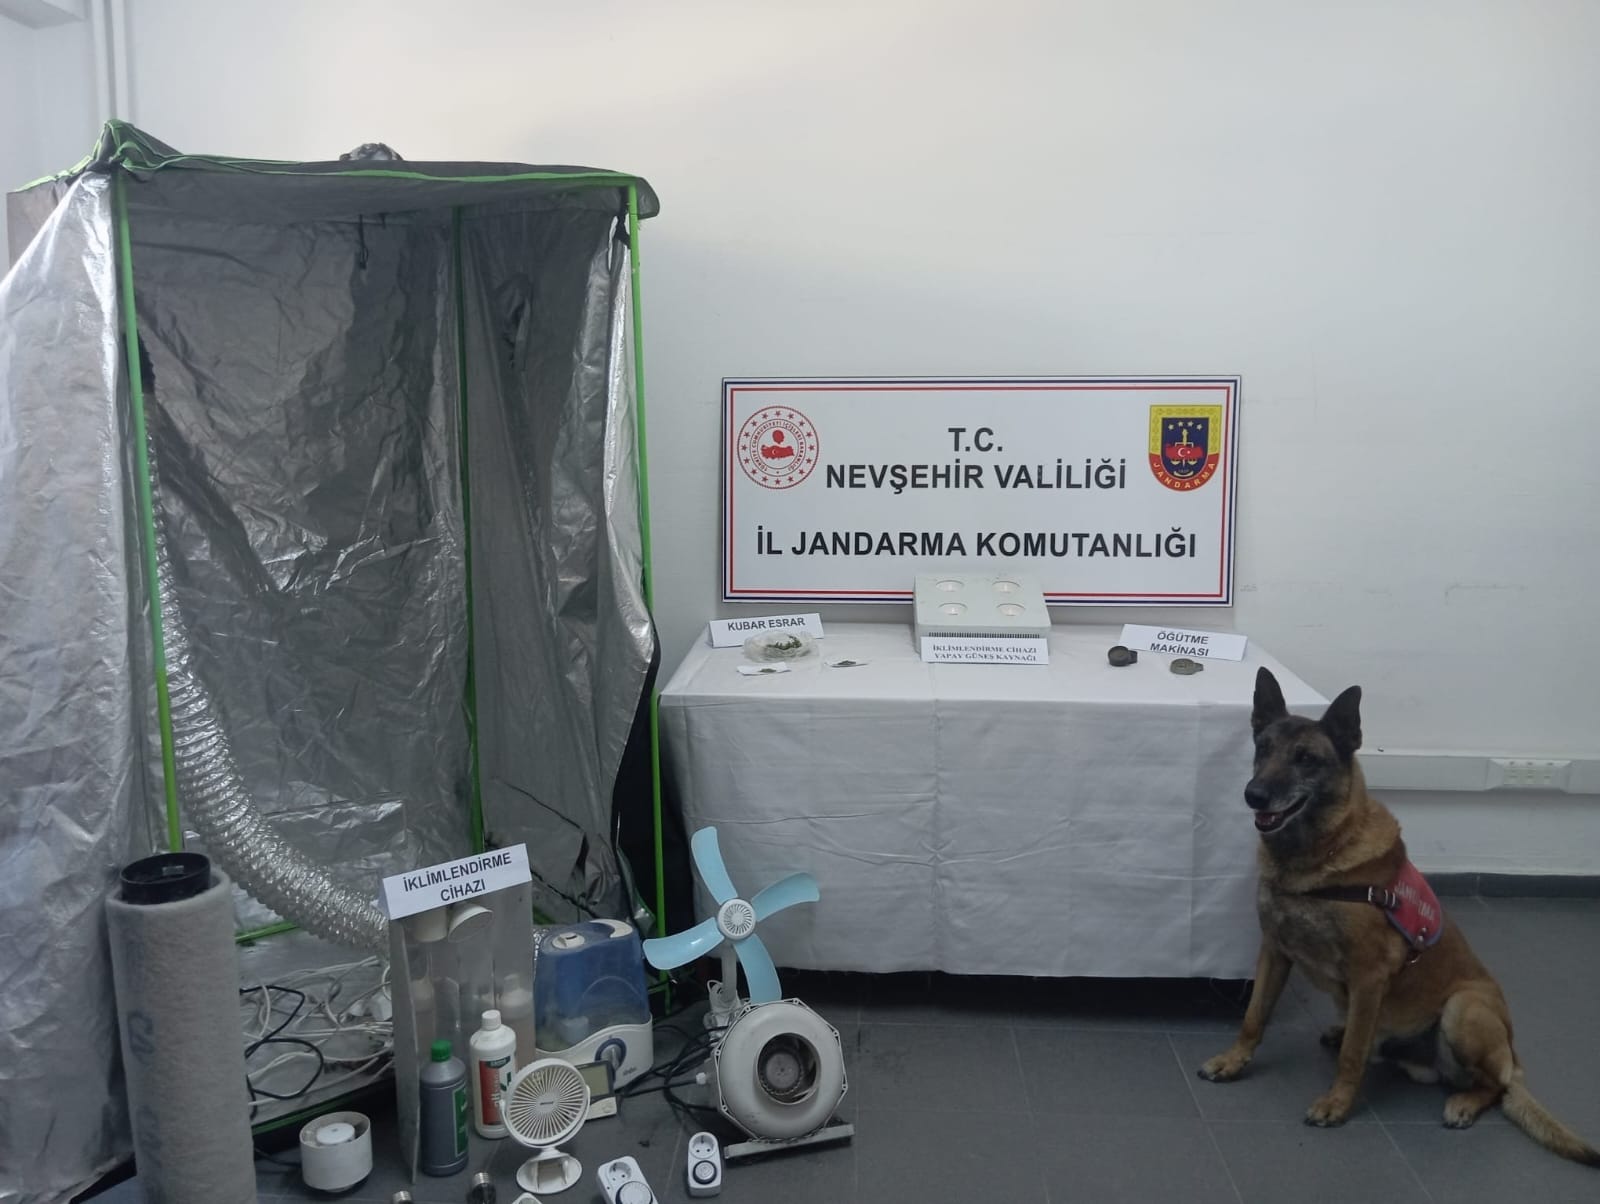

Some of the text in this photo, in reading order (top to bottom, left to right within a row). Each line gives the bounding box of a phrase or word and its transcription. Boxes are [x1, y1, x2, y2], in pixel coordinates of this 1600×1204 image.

[948, 427, 1003, 452] T.C.
[826, 458, 1126, 494] NEVŞEHİR VALİLİĞİ
[1153, 463, 1215, 488] JANDARMA
[757, 525, 1196, 557] İL JANDARMA KOMUTANLIĞI
[727, 617, 806, 631] KUBAR ESRAR
[933, 644, 1003, 652] İKLİMLENDİRME
[1157, 630, 1209, 645] ÖĞÜTME
[996, 653, 1036, 662] KAYNAĞI
[1150, 643, 1209, 657] MAKİNASI
[403, 852, 512, 892] İKLİMLENDİRME
[440, 879, 486, 902] CİHAZI
